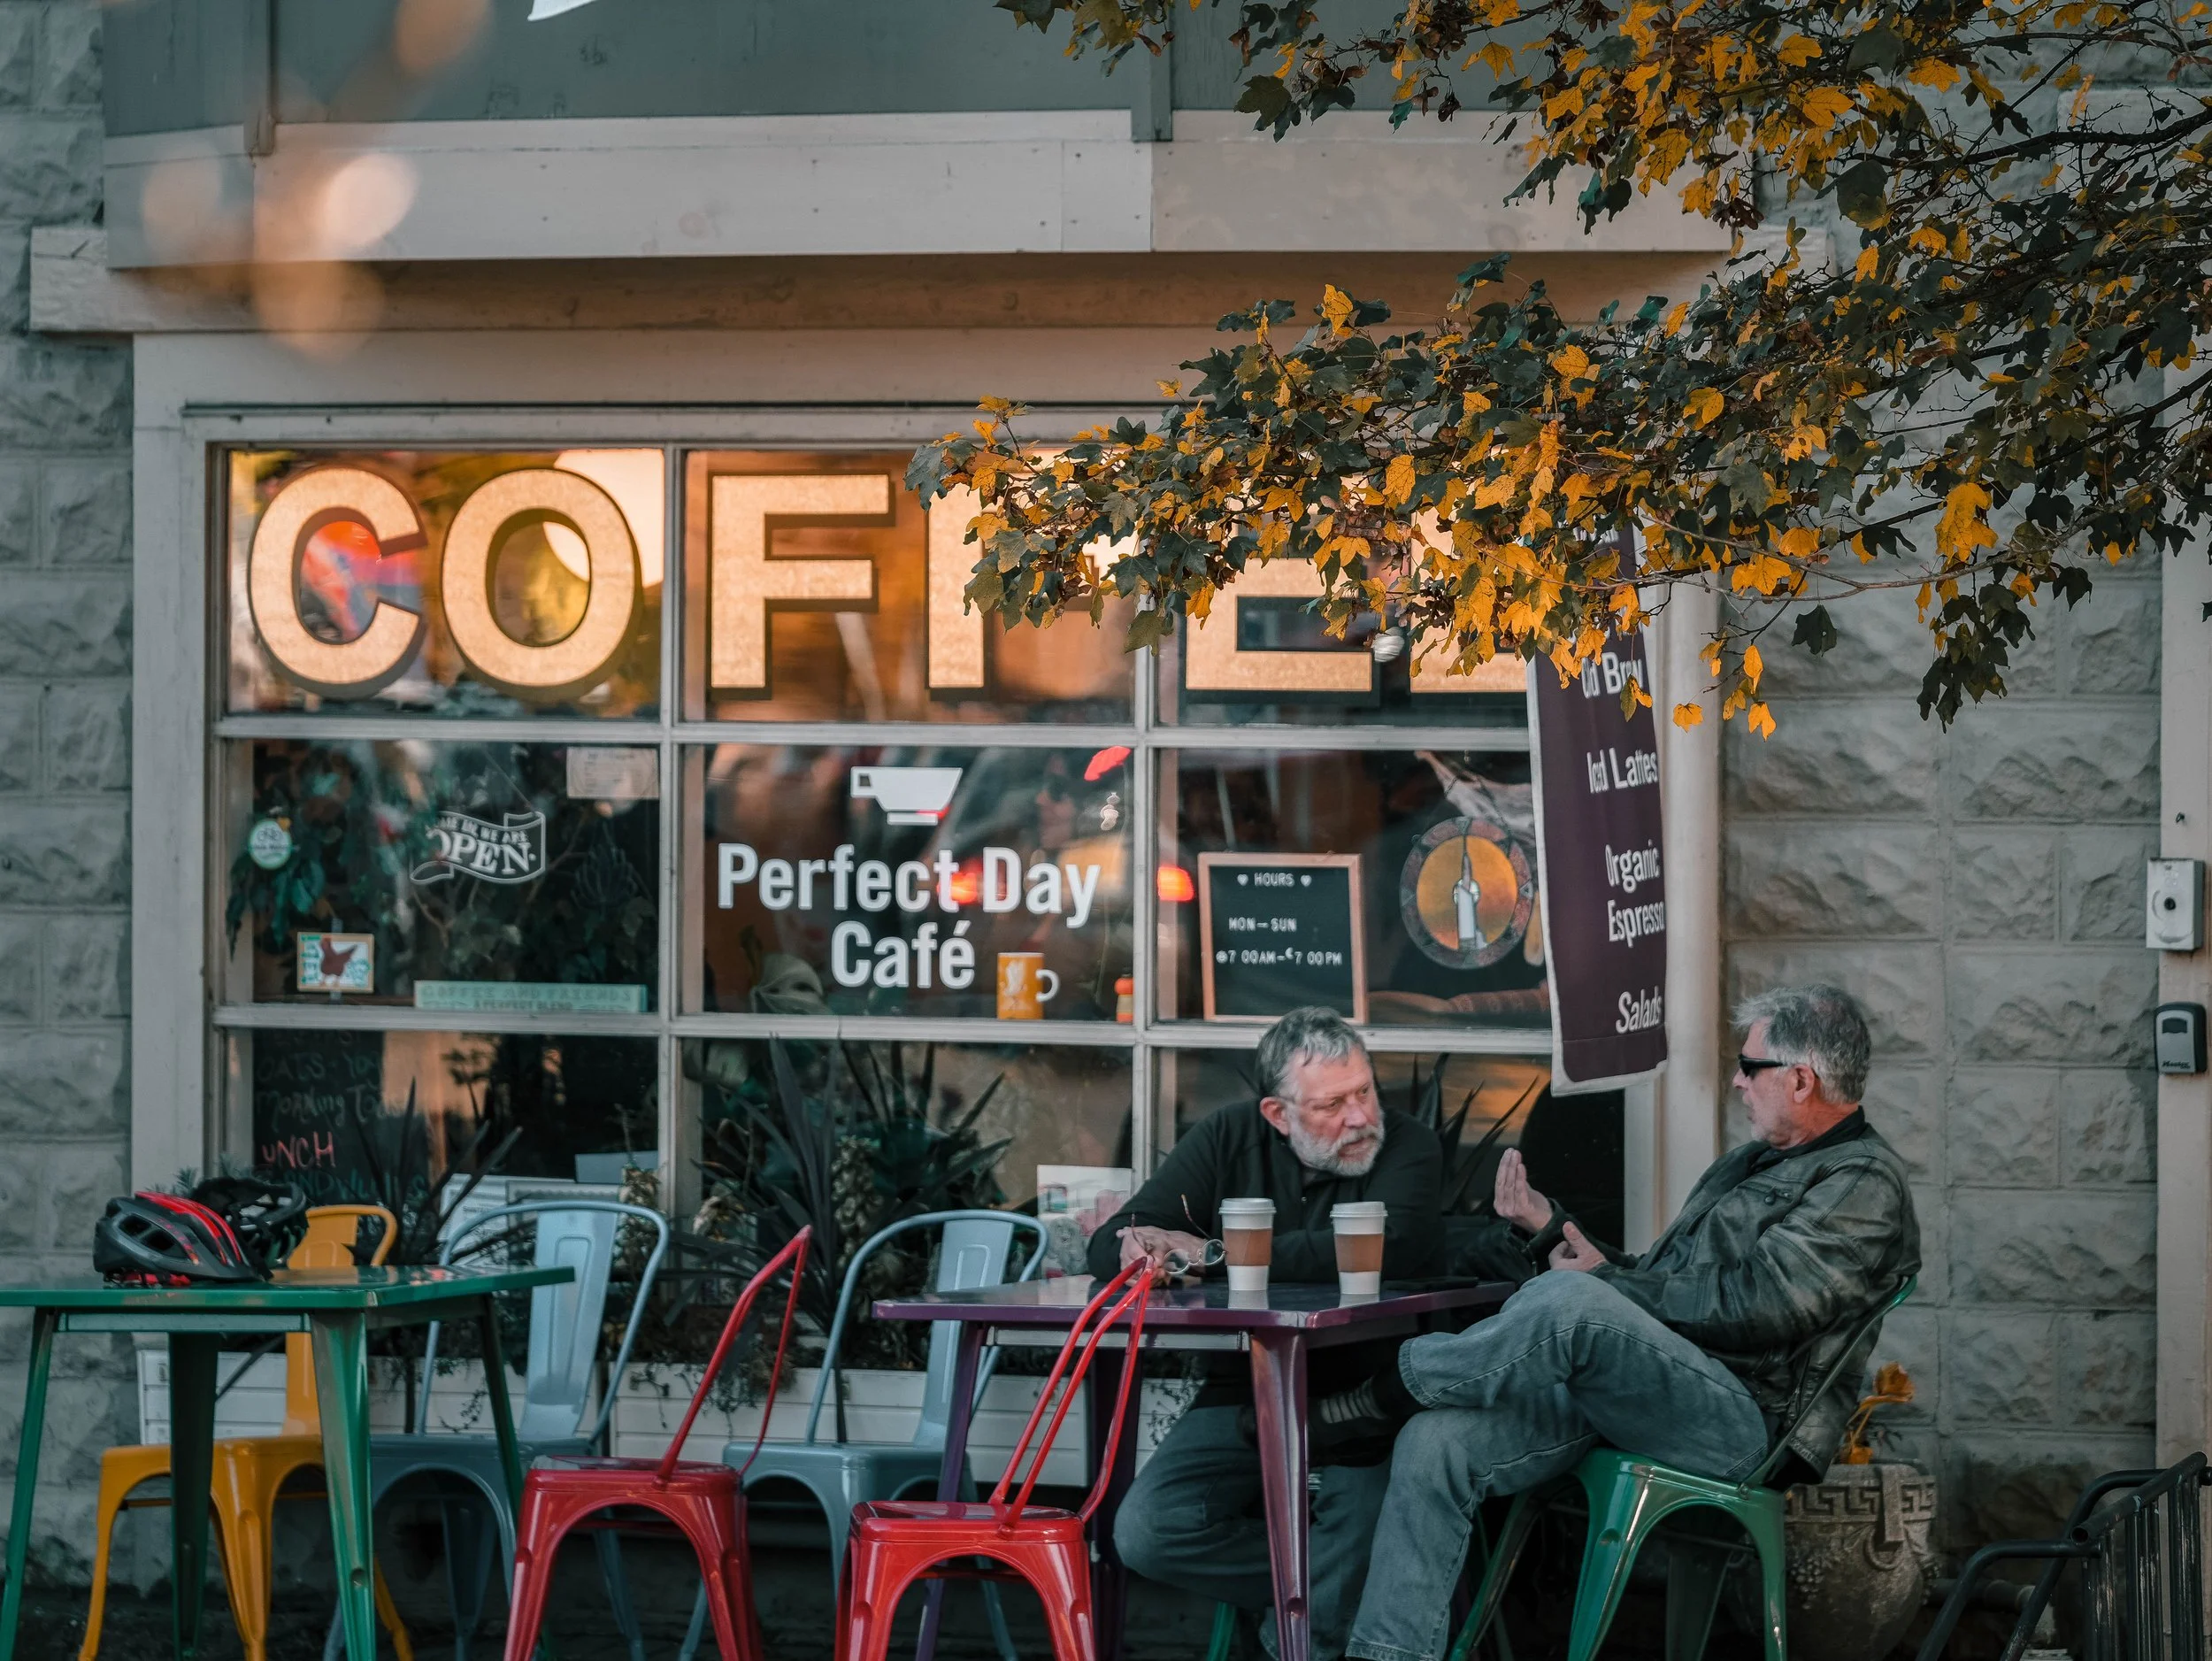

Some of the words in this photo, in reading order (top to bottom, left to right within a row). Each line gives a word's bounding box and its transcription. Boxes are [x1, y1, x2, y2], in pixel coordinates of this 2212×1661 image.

[1609, 748, 1658, 789] Lattes
[718, 843, 960, 913] Perfect
[983, 847, 1101, 929] Day
[1254, 872, 1295, 888] HOURS
[1605, 839, 1660, 894] Organic
[1607, 899, 1665, 949] Espresso
[831, 919, 975, 989] Café
[1615, 985, 1662, 1034] Salads
[262, 1131, 337, 1170] UNCH
